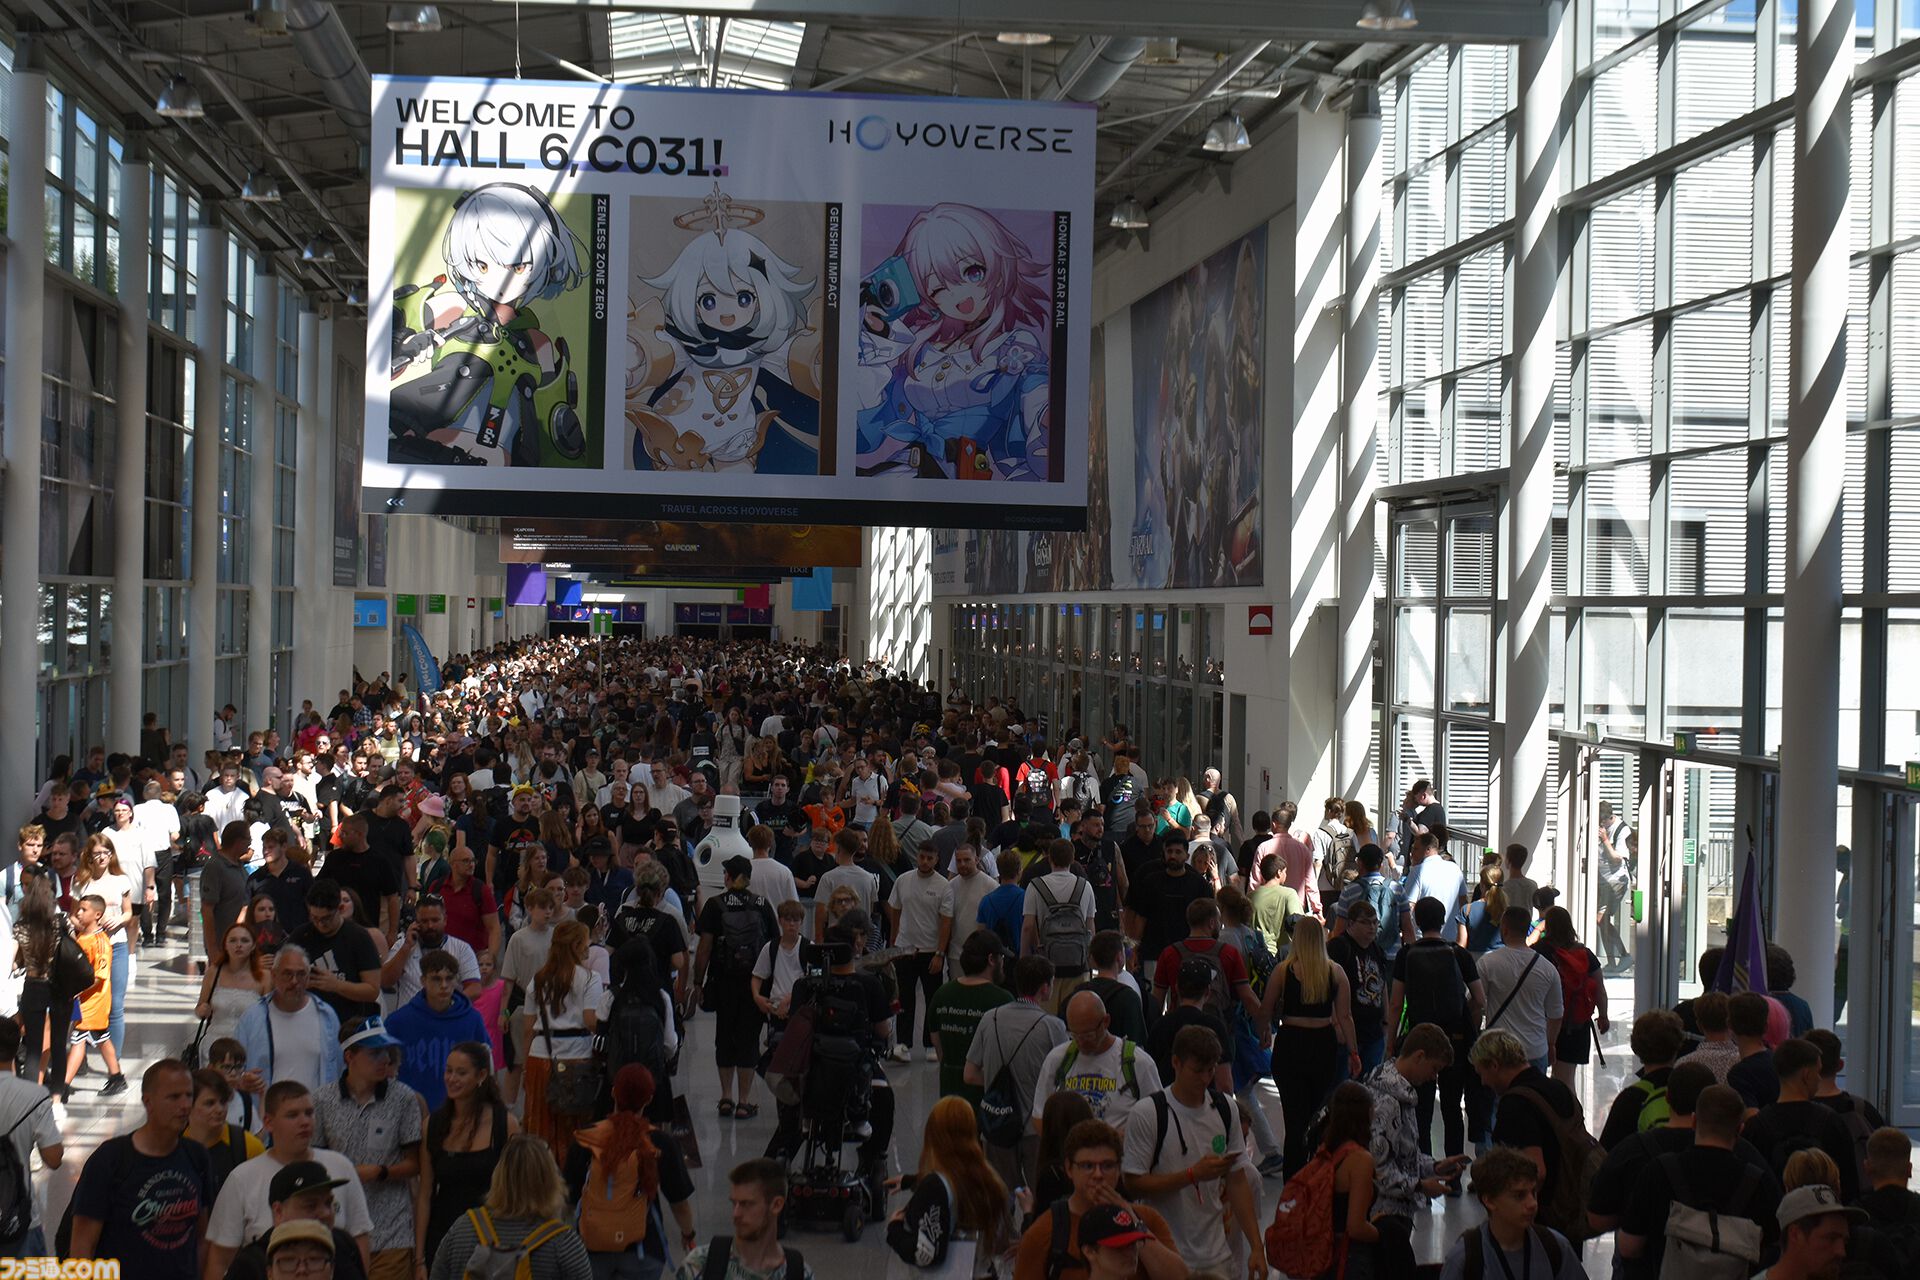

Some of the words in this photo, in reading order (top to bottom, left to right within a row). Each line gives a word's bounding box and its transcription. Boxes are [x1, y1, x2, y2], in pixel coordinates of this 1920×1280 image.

[396, 97, 576, 128] WELCOME
[588, 104, 635, 131] TO
[396, 127, 526, 169] HALL
[829, 114, 1073, 154] HOYOVERSE
[596, 198, 607, 250] ZENLESS
[829, 207, 839, 259] GENSHIN
[1057, 215, 1067, 265] HONKAI:
[596, 253, 606, 285] ZONE
[828, 262, 838, 309] IMPACT
[1056, 267, 1066, 299] STAR
[595, 288, 605, 320] ZERO
[1055, 301, 1065, 328] RAIL
[660, 503, 698, 515] TRAVEL
[700, 504, 739, 516] ACROSS
[740, 505, 799, 517] HOYOVERSE
[664, 544, 699, 552] CAPCOM
[1065, 1077, 1079, 1091] NO
[1080, 1076, 1117, 1092] RETURN
